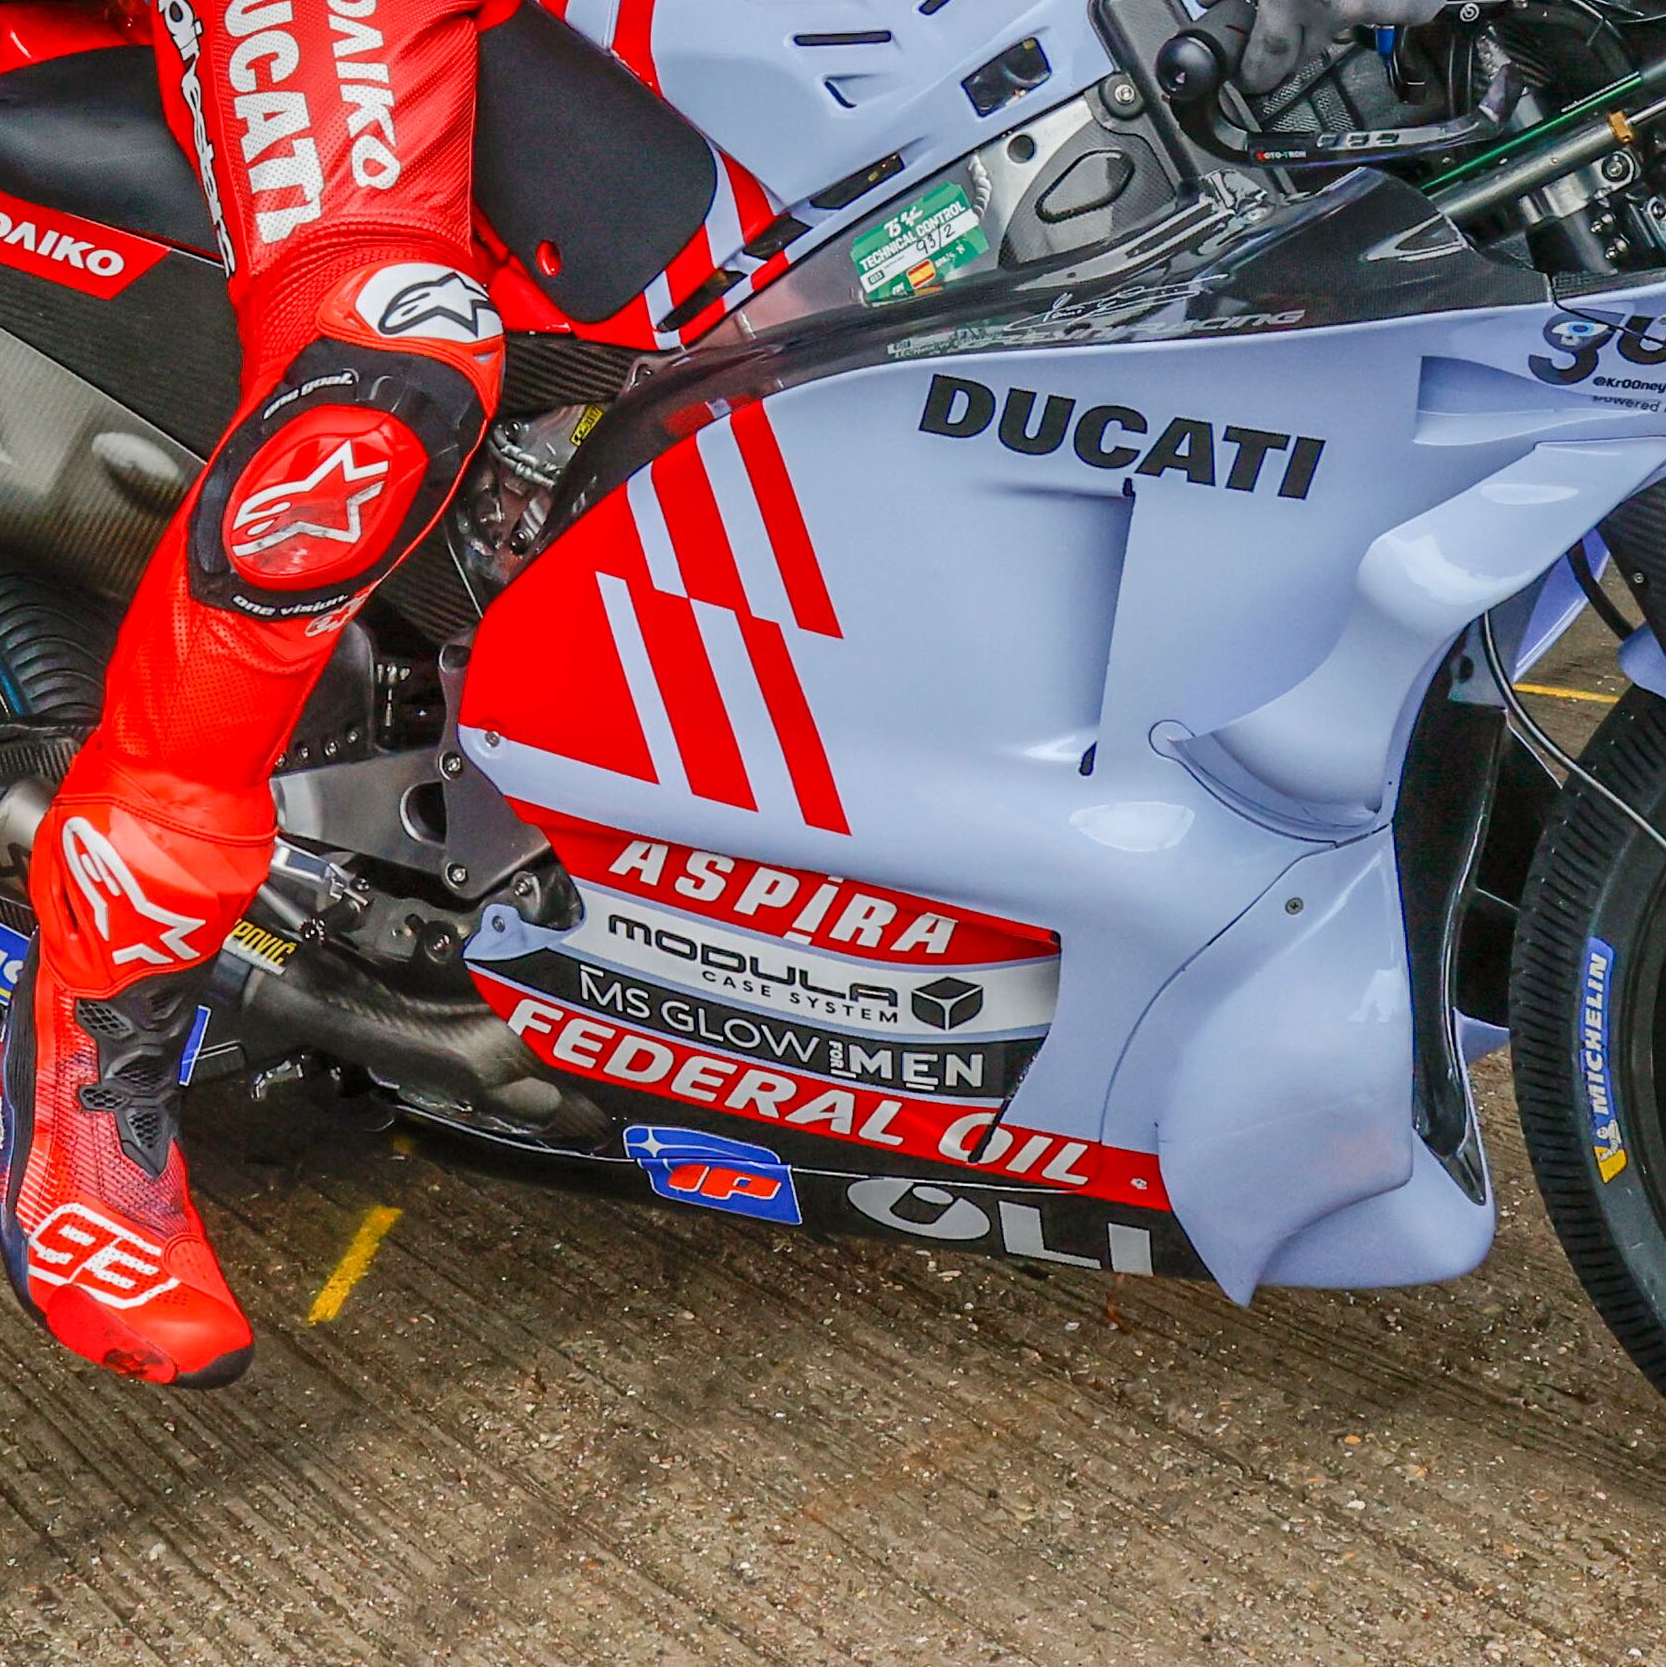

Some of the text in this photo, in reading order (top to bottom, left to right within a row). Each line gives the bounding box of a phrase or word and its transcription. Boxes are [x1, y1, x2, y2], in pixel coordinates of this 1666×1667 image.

[858, 230, 919, 272] TECHNICAL
[915, 200, 967, 240] CONTROL
[917, 373, 1327, 502] DUCATI
[1593, 394, 1660, 414] powered
[233, 595, 276, 616] one
[233, 917, 298, 969] POVIČ
[608, 837, 960, 956] ASPIRA
[607, 912, 900, 1008] MODULA
[701, 969, 900, 1025] CASE SYSTEM
[579, 965, 984, 1091] MS GLOW FOR MEN
[1581, 951, 1607, 1117] MICHELIN
[506, 996, 1092, 1187] FEDERAL OIL
[667, 1162, 784, 1201] IP
[845, 1178, 1154, 1279] OLI
